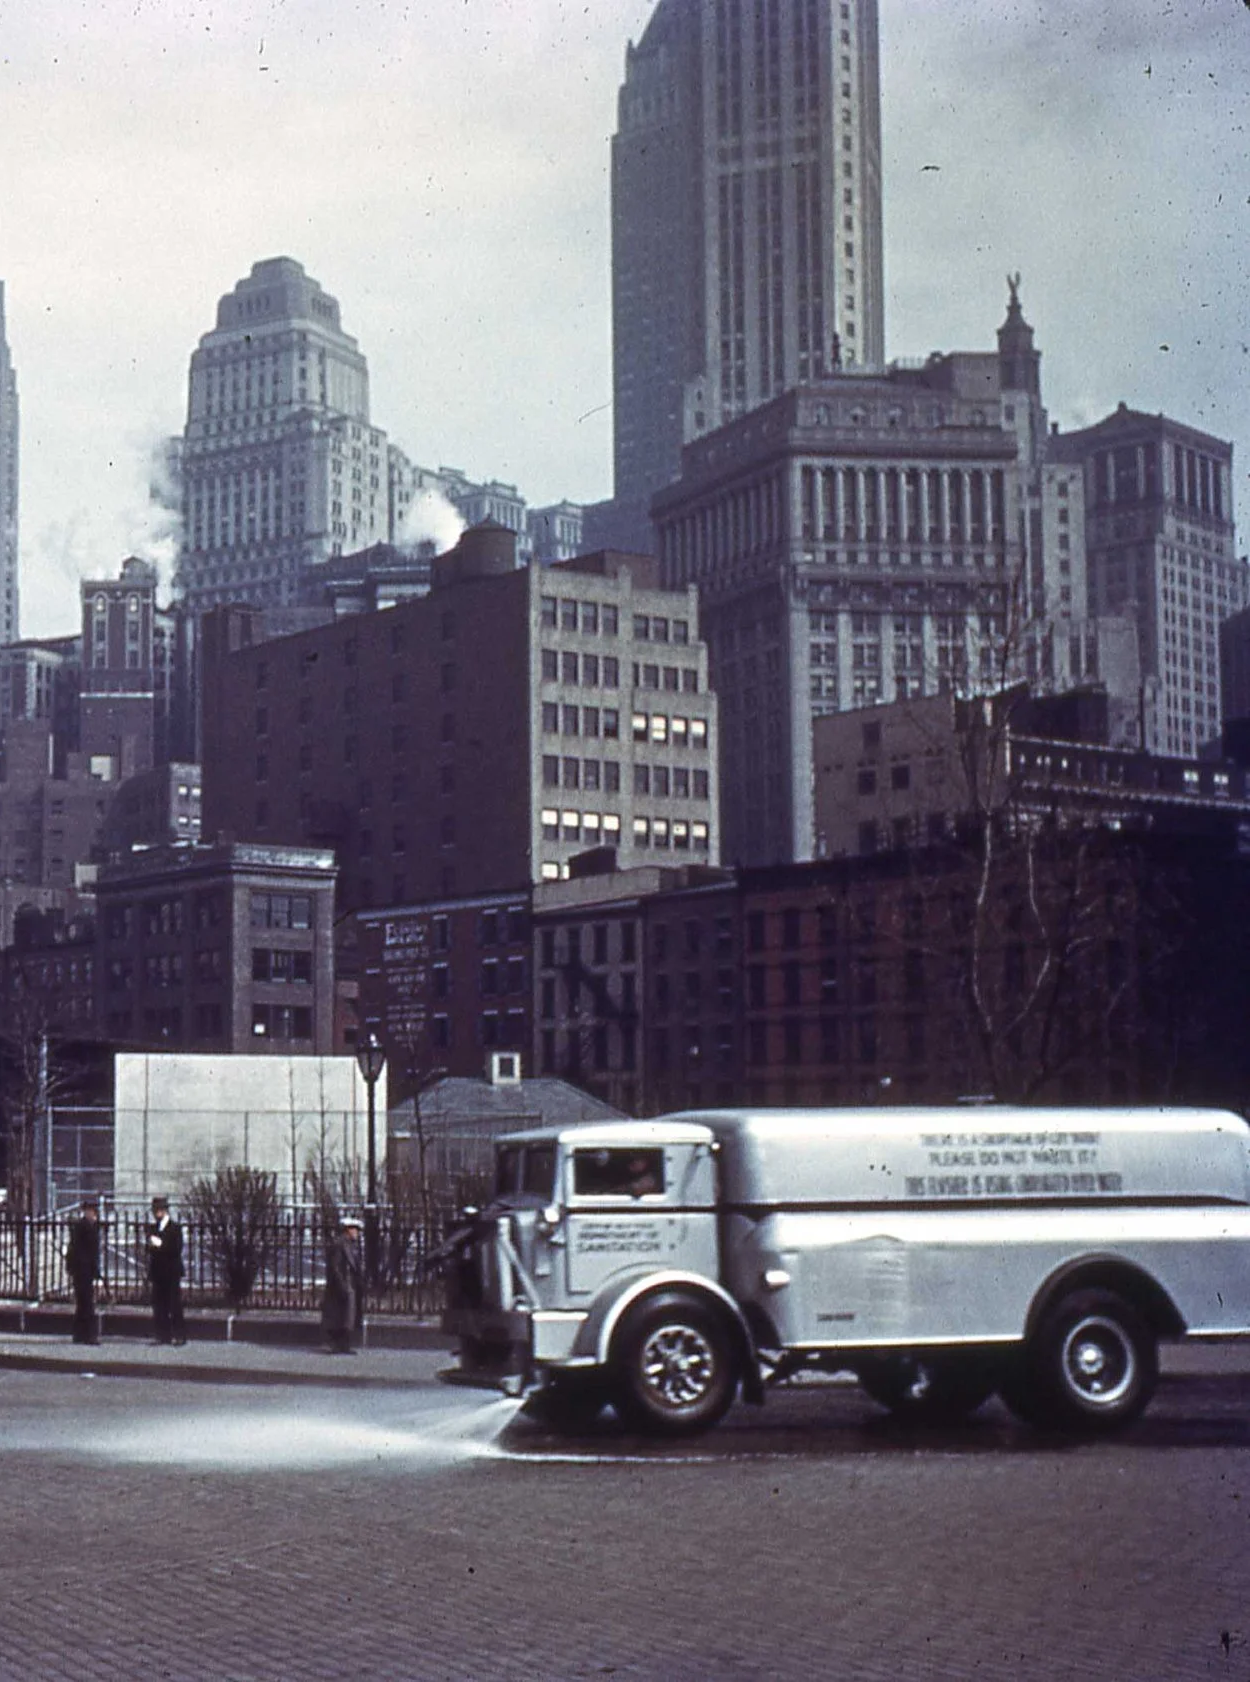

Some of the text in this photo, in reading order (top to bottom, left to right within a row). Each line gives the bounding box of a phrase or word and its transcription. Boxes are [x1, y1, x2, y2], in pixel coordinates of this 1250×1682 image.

[929, 1152, 976, 1167] PLEASE
[979, 1151, 1000, 1165] DO
[1002, 1151, 1028, 1165] NOT
[577, 1241, 661, 1252] SANITATION
